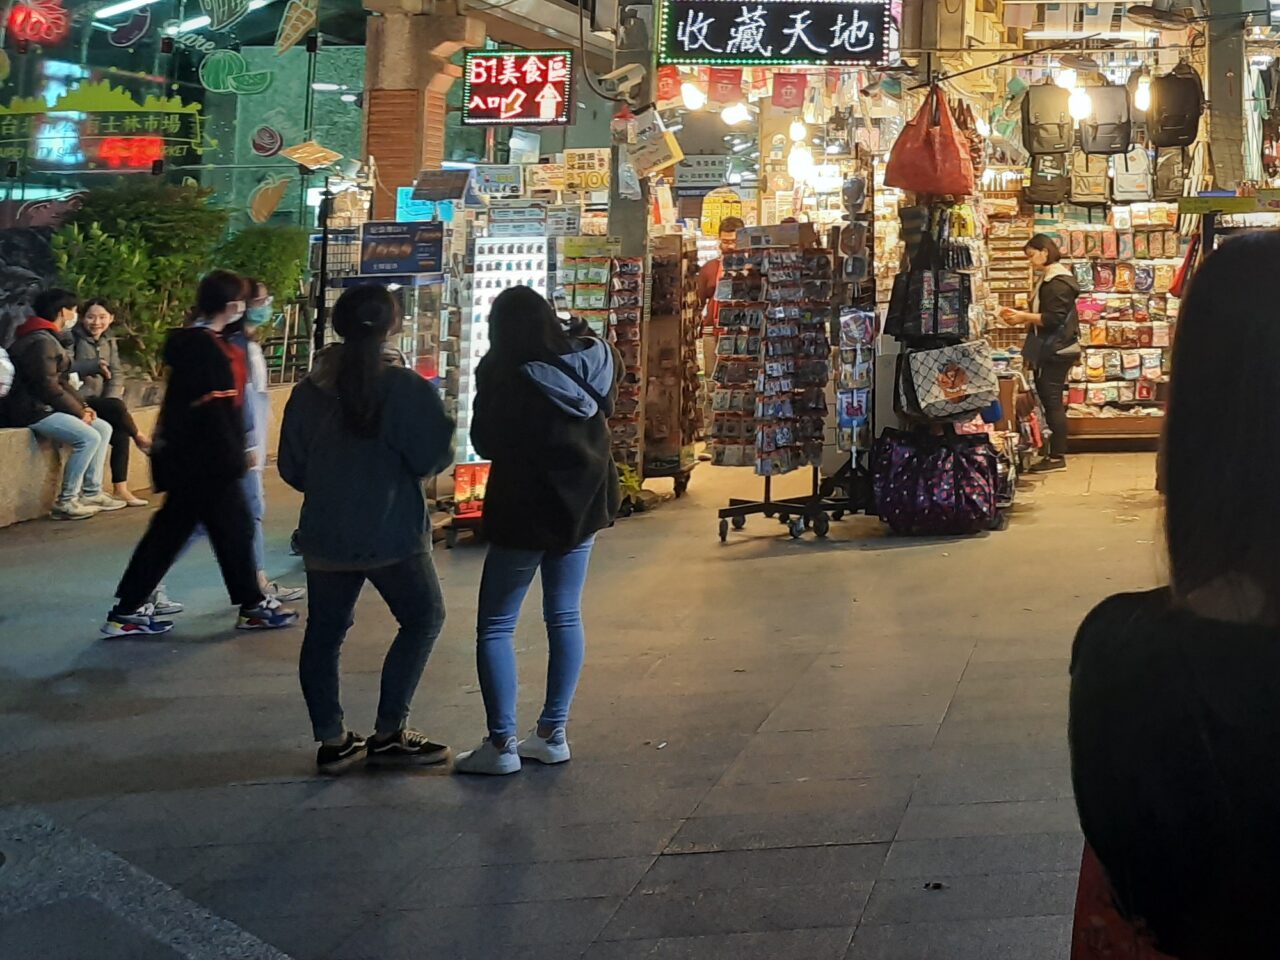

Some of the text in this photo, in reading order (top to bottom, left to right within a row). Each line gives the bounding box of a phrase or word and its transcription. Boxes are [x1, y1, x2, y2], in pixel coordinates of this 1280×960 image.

[676, 5, 875, 56] 收藏天地
[468, 55, 569, 85] B1美食區
[468, 94, 506, 110] 入口
